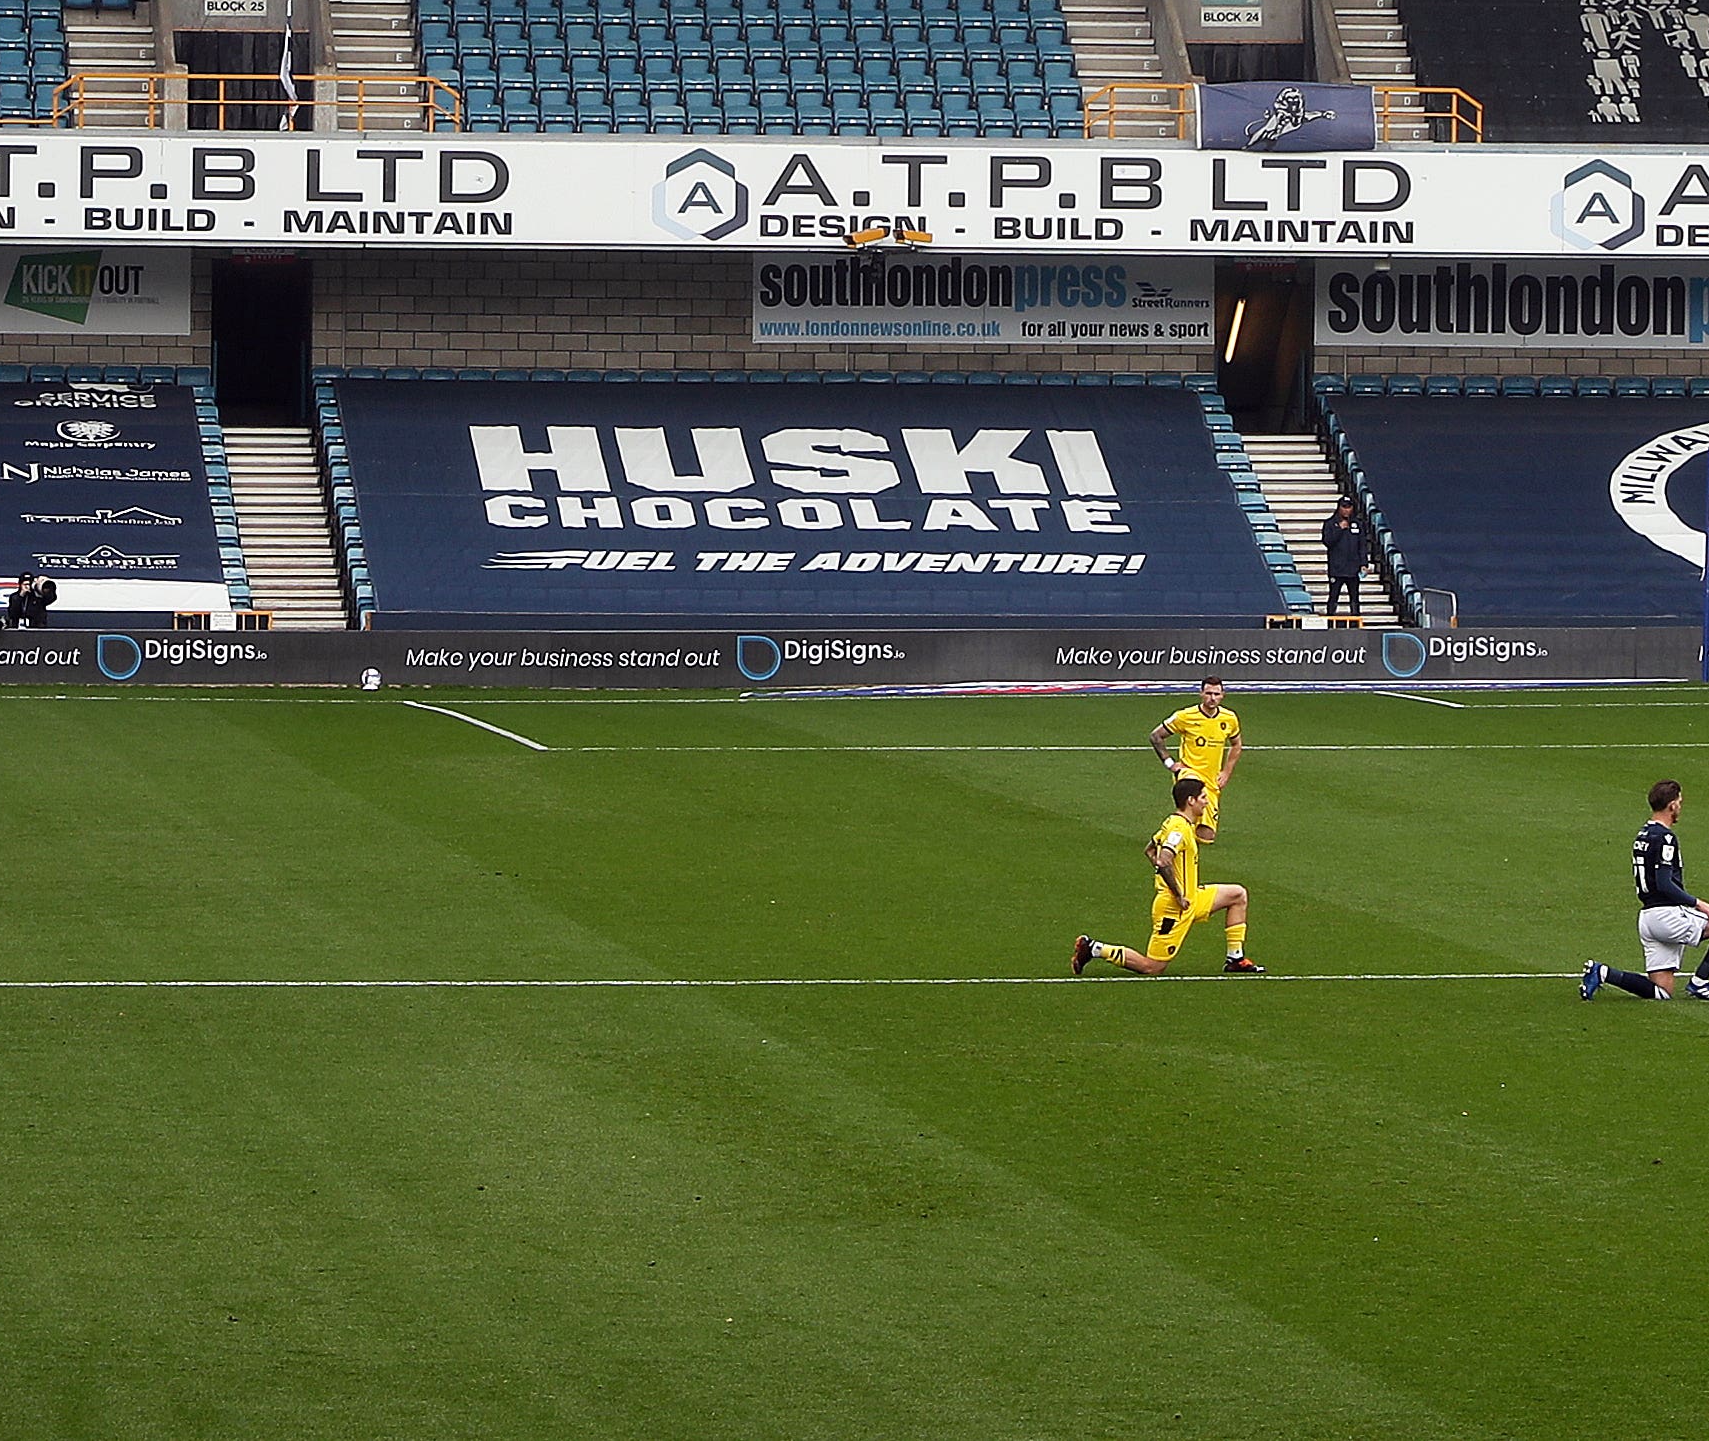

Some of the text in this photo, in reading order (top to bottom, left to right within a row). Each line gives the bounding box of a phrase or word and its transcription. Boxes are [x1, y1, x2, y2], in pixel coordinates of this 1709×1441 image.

[207, 1, 265, 12] BLOCK 25
[1203, 12, 1261, 23] BLOCK 24
[307, 149, 509, 203] LTD
[1213, 159, 1411, 212] LTD
[85, 208, 215, 231] BUILD
[284, 211, 511, 235] MAINTAIN
[760, 215, 1413, 243] DESIGN BUILD MAINTAIN
[22, 264, 144, 295] KICK OUT
[760, 258, 1127, 312] southlondonpress
[759, 320, 1001, 337] www.londonnewsonline.co.uk
[1020, 321, 1210, 341] for all your news & sport
[14, 399, 158, 409] GRAPHICS
[39, 392, 156, 404] SERVICE
[43, 466, 123, 477] Nicholas
[125, 469, 192, 479] James
[469, 425, 1118, 498] HUSKI
[482, 493, 1132, 535] CHOCOLATE
[77, 557, 176, 568] Supplies
[517, 549, 1146, 576] FUEL THE ADVENTURE!
[45, 648, 81, 665] out
[406, 648, 463, 666] Make
[469, 651, 518, 671] your
[521, 648, 614, 667] business
[619, 648, 681, 667] stand
[685, 649, 721, 667] out
[1056, 646, 1113, 664] Make
[1118, 649, 1166, 670] your
[1169, 646, 1262, 665] business
[1266, 645, 1328, 664] stand
[1332, 646, 1368, 664] out
